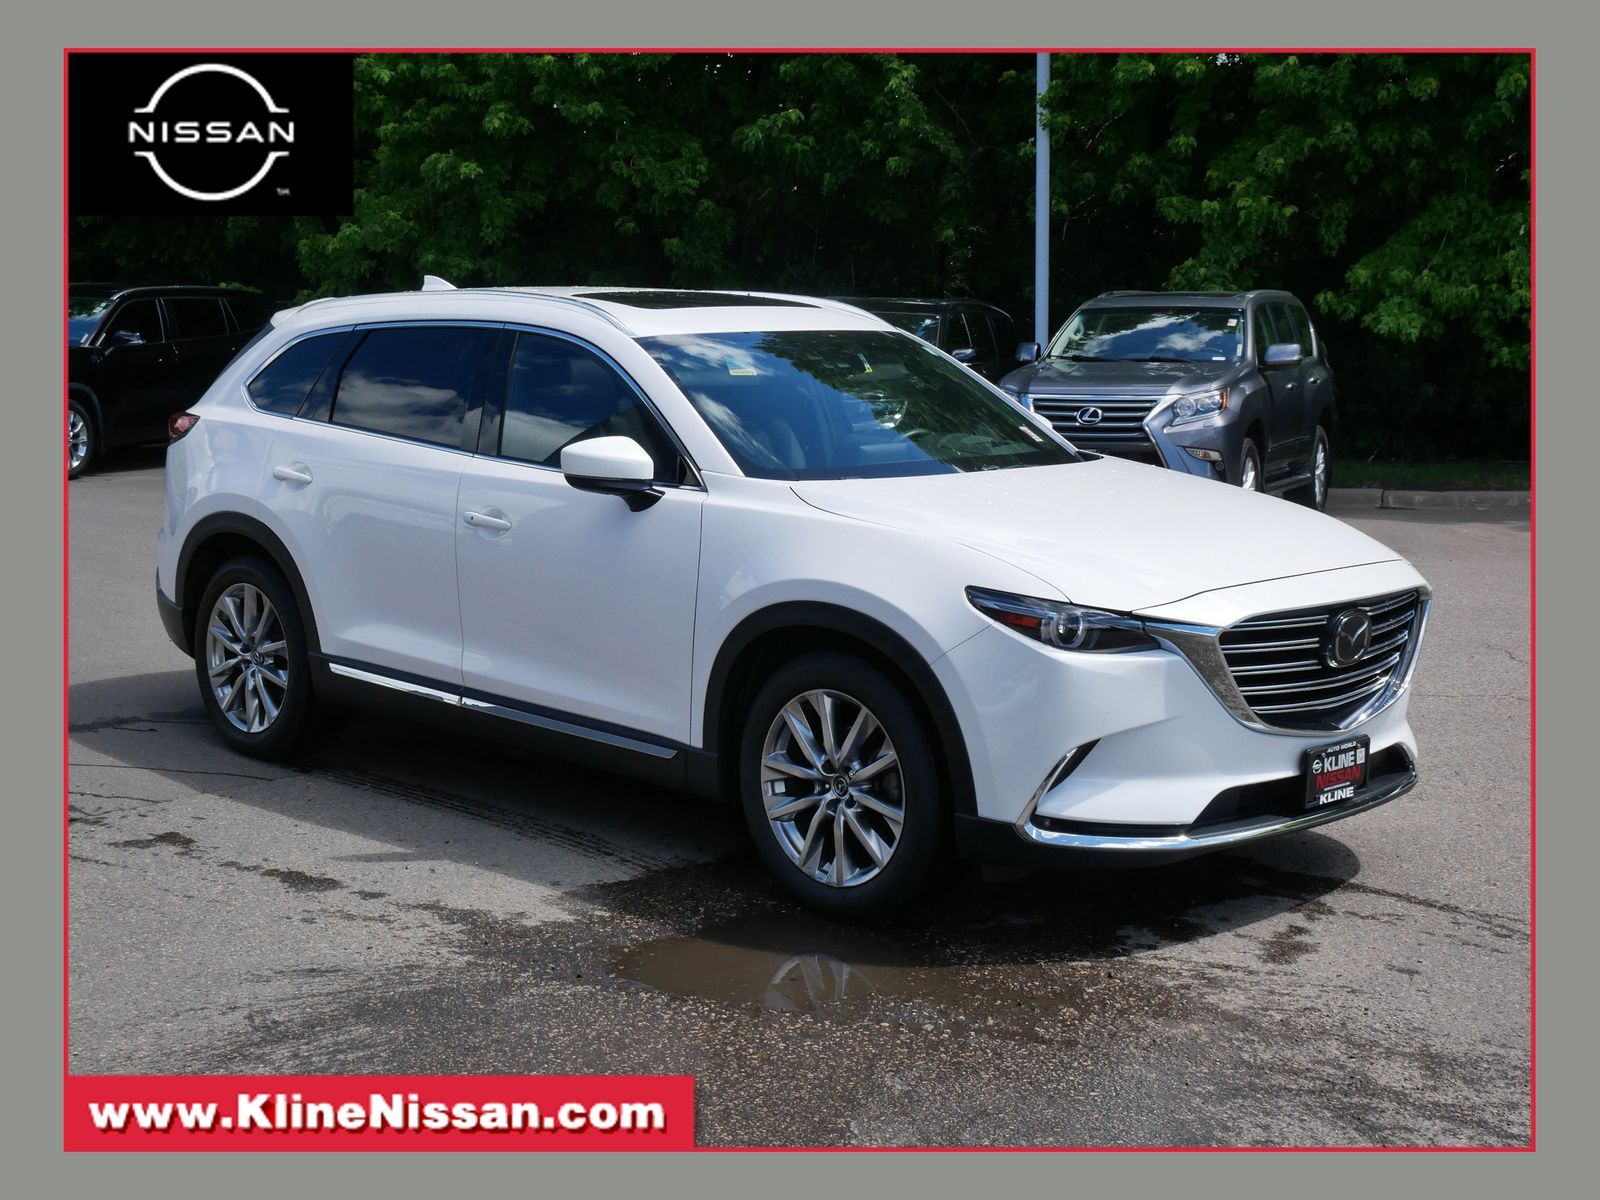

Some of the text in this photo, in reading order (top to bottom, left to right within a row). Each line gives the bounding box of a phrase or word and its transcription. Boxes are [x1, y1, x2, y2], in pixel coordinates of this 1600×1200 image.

[1327, 741, 1357, 753] AUTO WORLD
[1324, 751, 1355, 773] KLINE
[1316, 764, 1361, 789] NISSAN
[1320, 786, 1354, 804] KLINE
